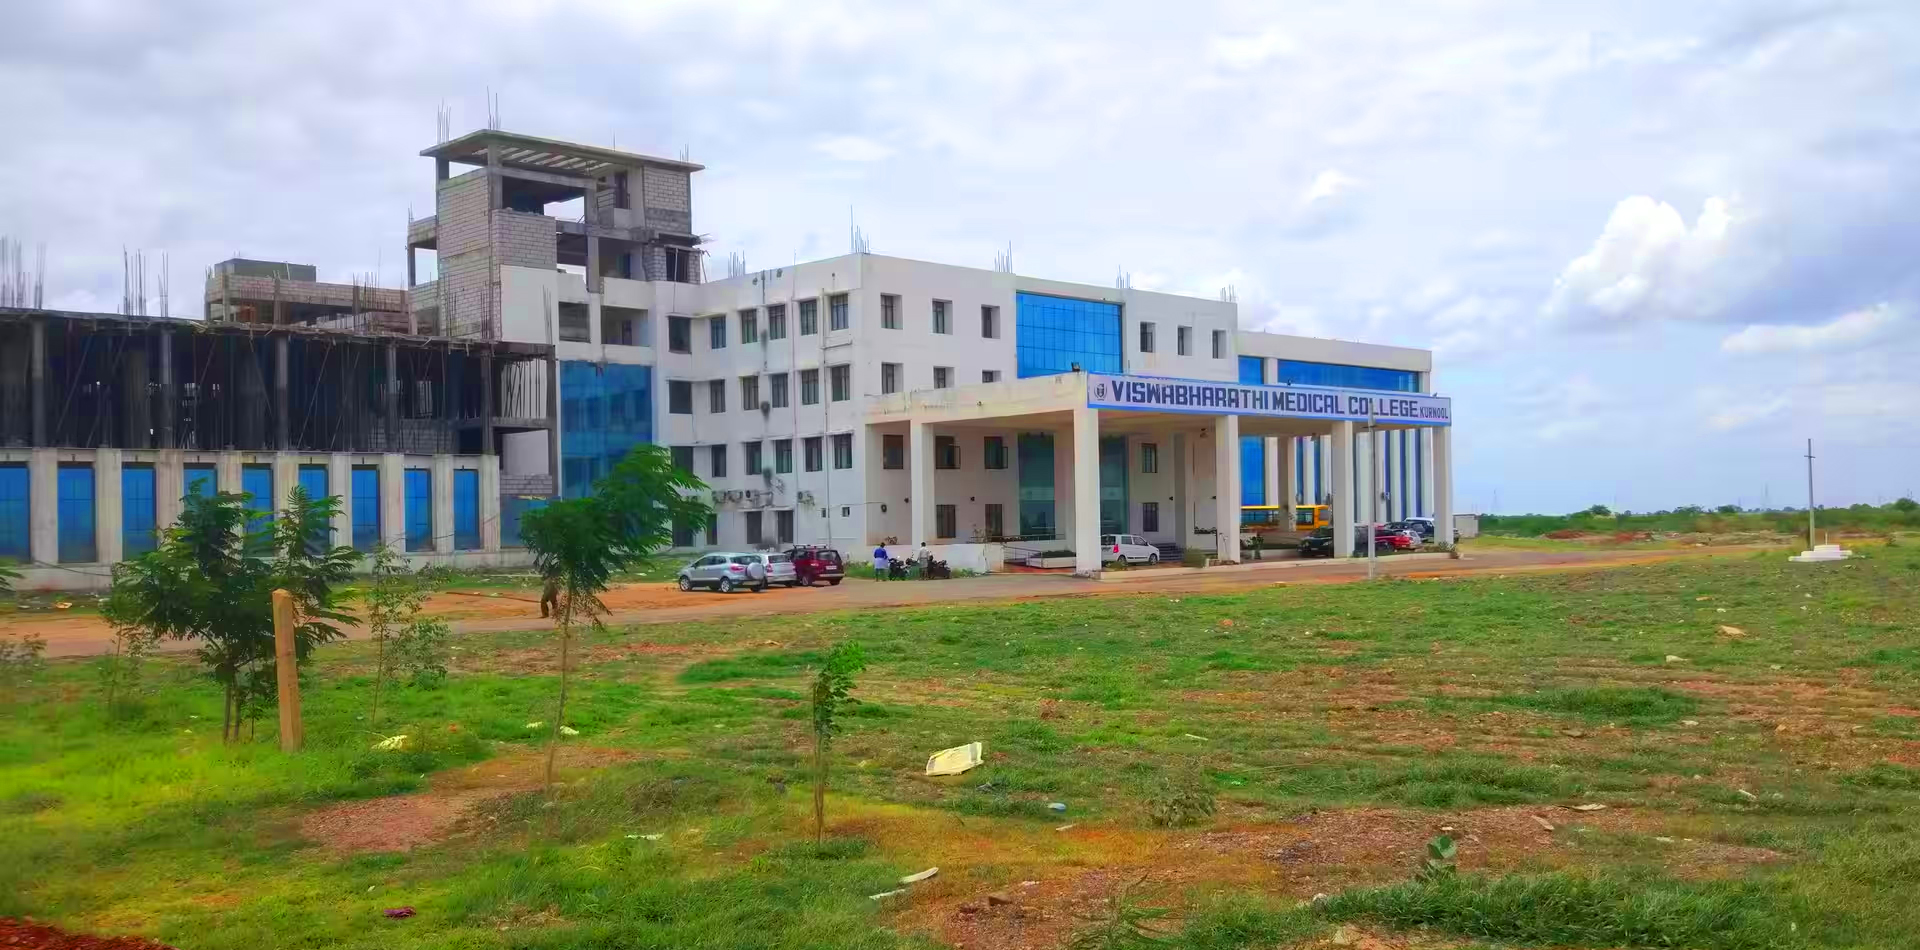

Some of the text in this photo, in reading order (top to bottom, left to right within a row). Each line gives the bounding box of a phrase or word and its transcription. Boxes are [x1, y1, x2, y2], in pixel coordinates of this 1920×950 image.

[1111, 380, 1269, 410] VISWABHARATHI
[1272, 391, 1345, 414] MEDICAL
[1419, 406, 1448, 419] KURNOOL
